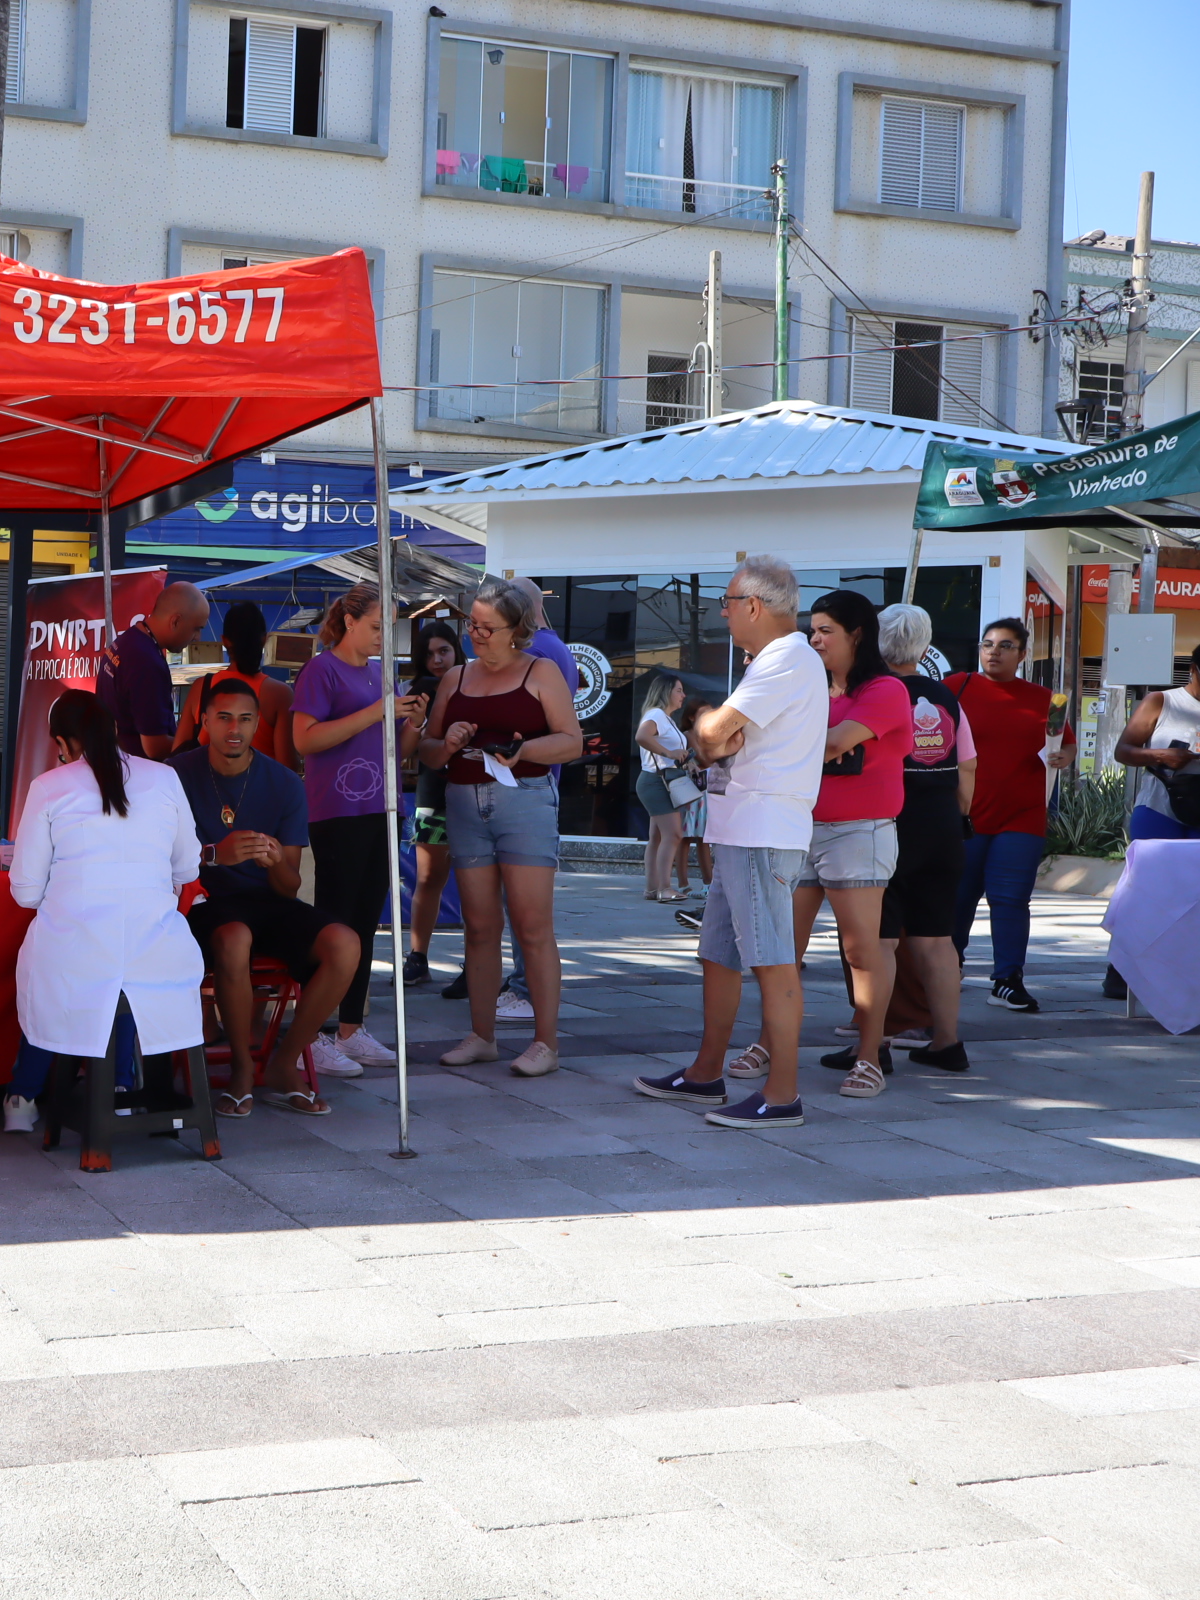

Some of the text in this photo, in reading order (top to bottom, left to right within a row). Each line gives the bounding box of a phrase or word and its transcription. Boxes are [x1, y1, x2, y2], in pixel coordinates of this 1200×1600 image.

[12, 286, 285, 345] 3231-6577
[1032, 434, 1179, 477] Prefeitura de
[1068, 468, 1148, 499] Vinhedo
[250, 484, 430, 533] agiba
[1087, 577, 1109, 588] Coca-Col
[26, 660, 33, 680] A
[34, 657, 66, 680] PIPOCA
[67, 652, 73, 678] É
[73, 656, 91, 678] POR
[568, 644, 603, 662] ULHEIRO
[580, 656, 602, 692] MUNICIPAL
[573, 699, 590, 710] EDO
[585, 694, 607, 717] AMIGO
